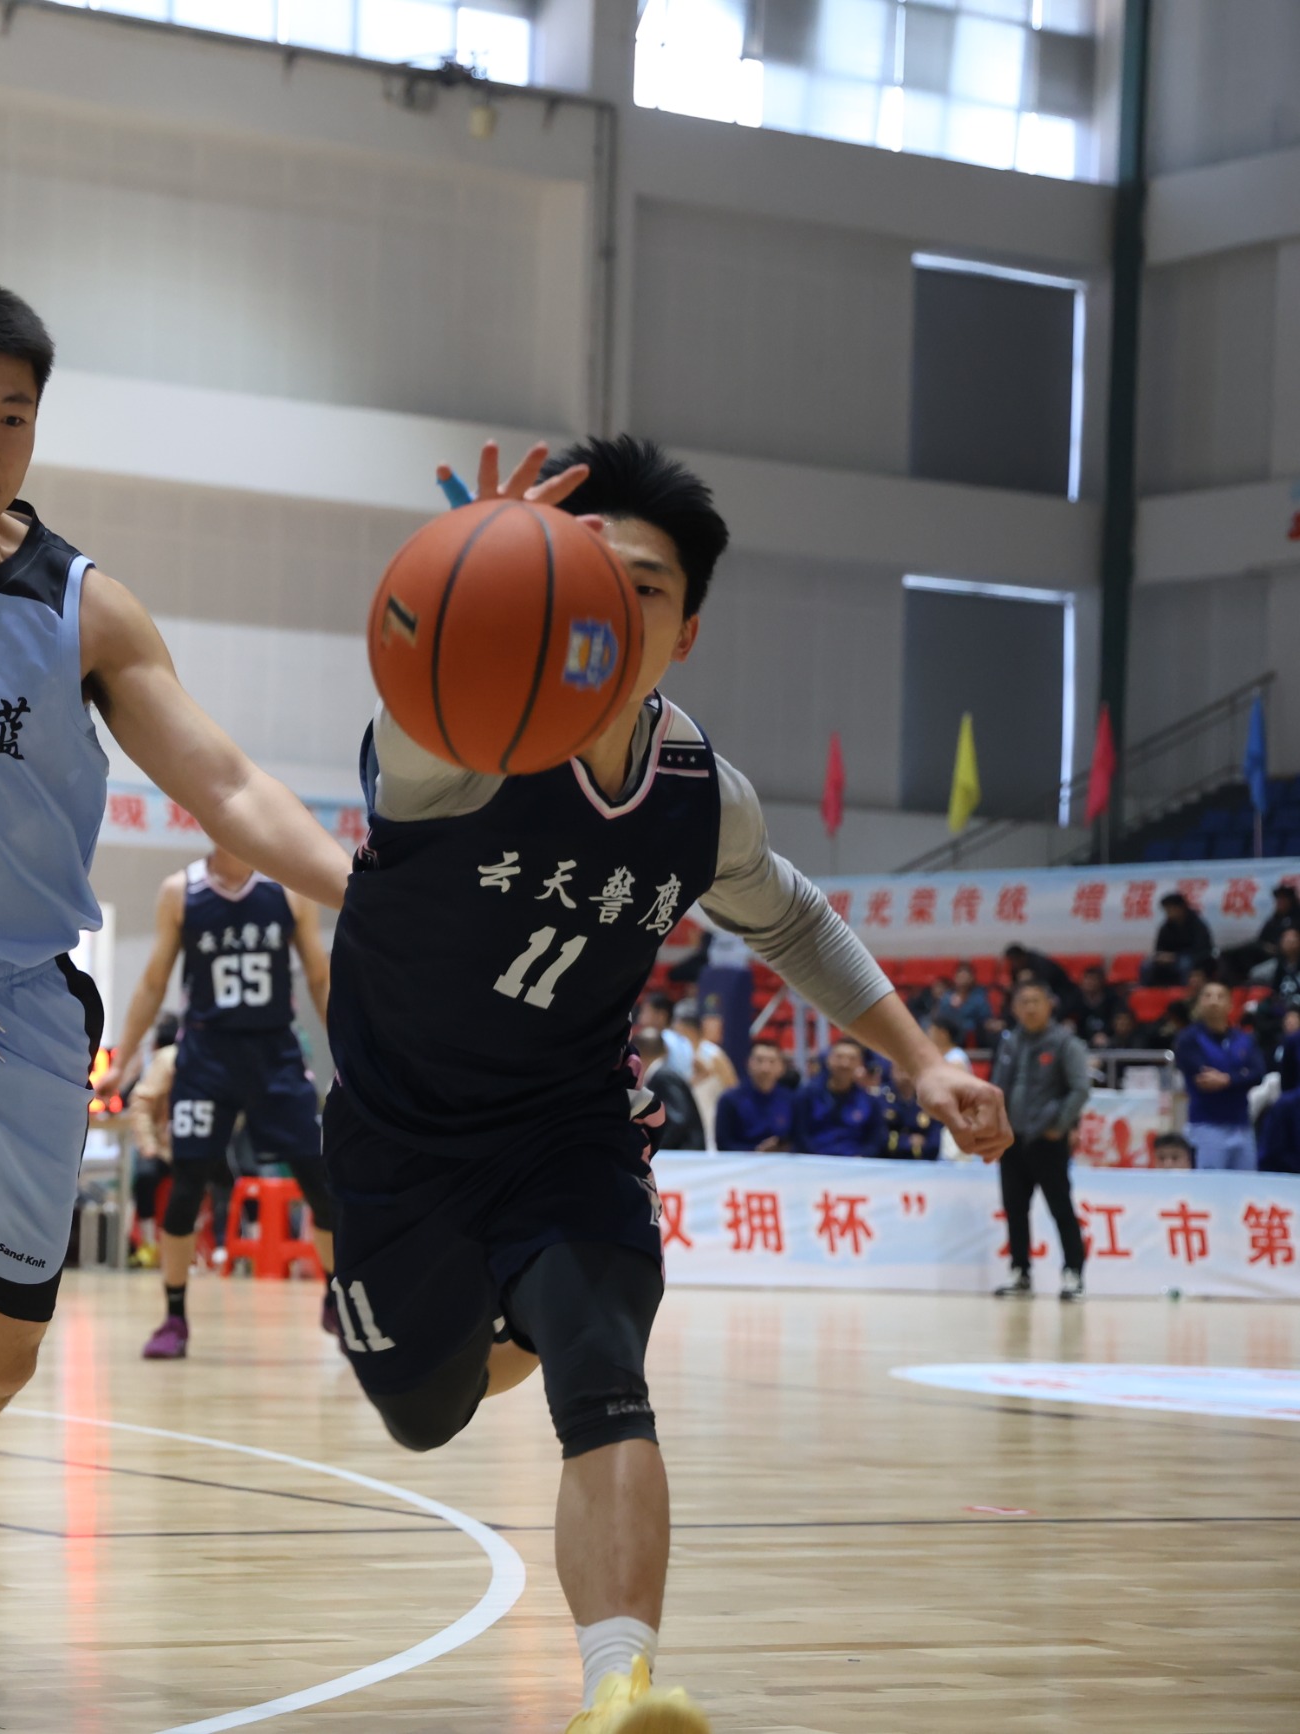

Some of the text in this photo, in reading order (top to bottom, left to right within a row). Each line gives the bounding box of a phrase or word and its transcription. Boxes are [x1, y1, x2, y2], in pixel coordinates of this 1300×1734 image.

[478, 851, 683, 936] 云天警鹰
[211, 952, 273, 1009] 65
[493, 926, 588, 1010] 11
[172, 1100, 215, 1138] 65
[330, 1276, 396, 1353] 11
